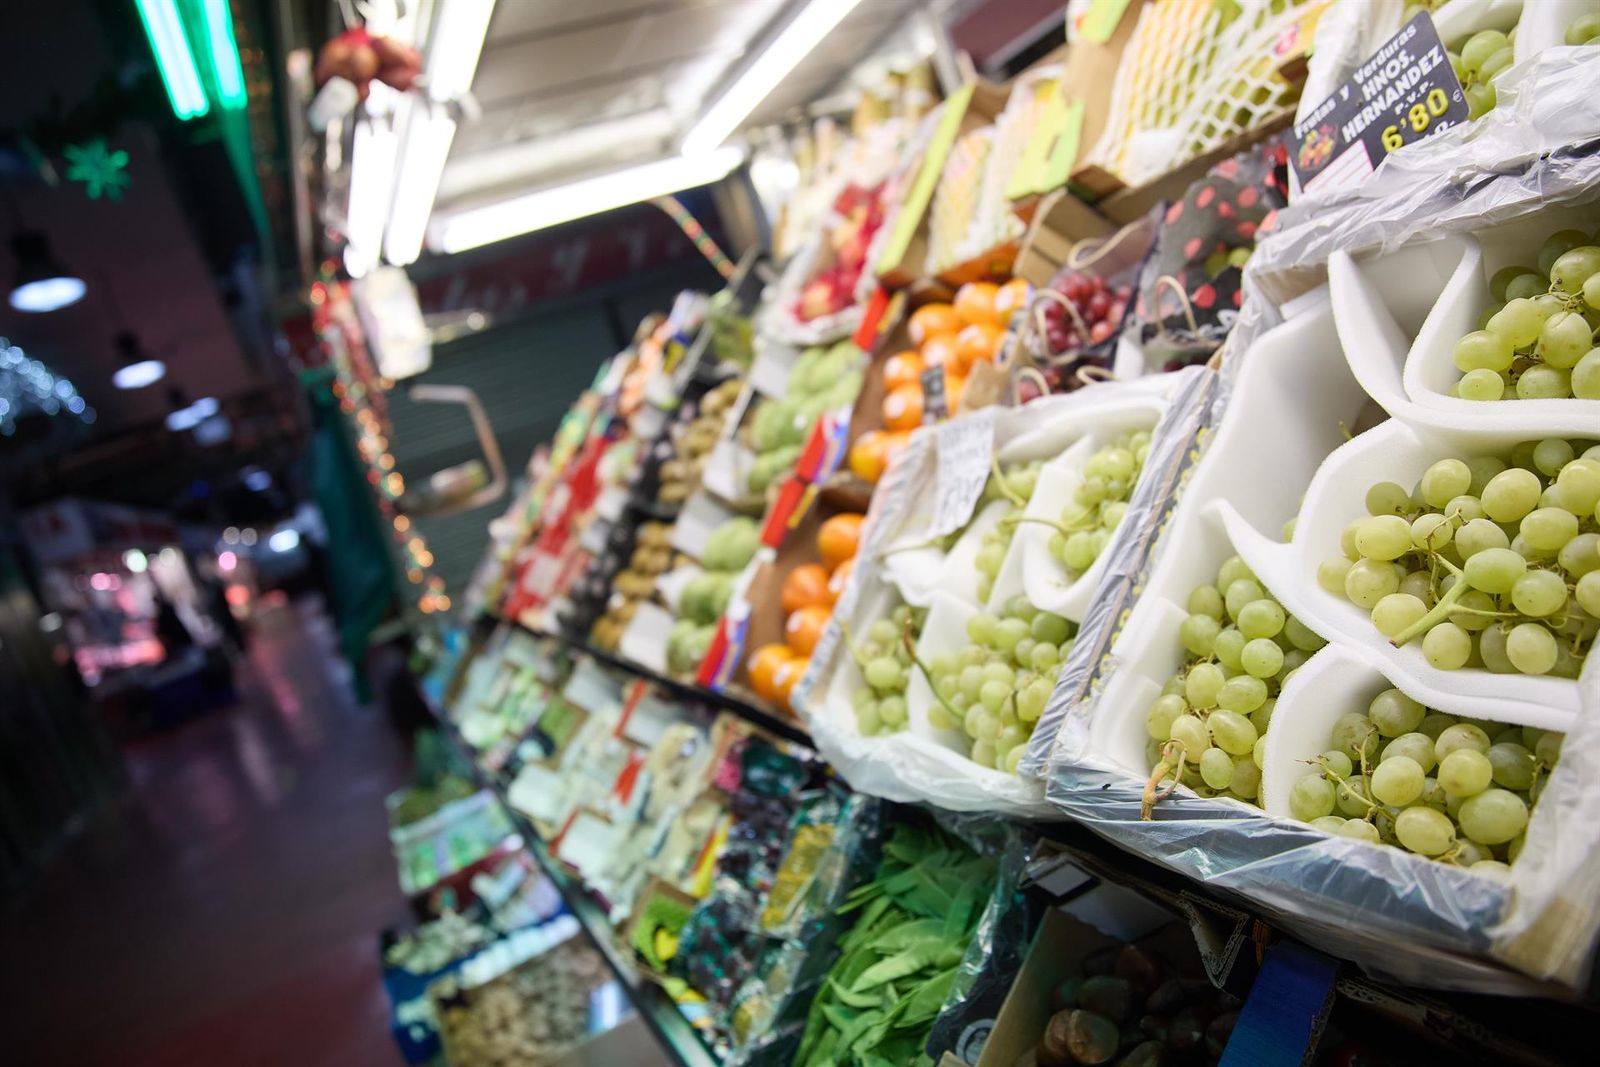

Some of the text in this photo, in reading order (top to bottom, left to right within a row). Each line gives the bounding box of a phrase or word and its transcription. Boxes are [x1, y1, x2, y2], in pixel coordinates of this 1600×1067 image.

[1339, 84, 1350, 102] y
[1353, 24, 1417, 85] Verduras
[1341, 45, 1444, 143] HERNANDEZ
[1361, 49, 1416, 102] HNOS.
[1381, 88, 1450, 153] 6'80
